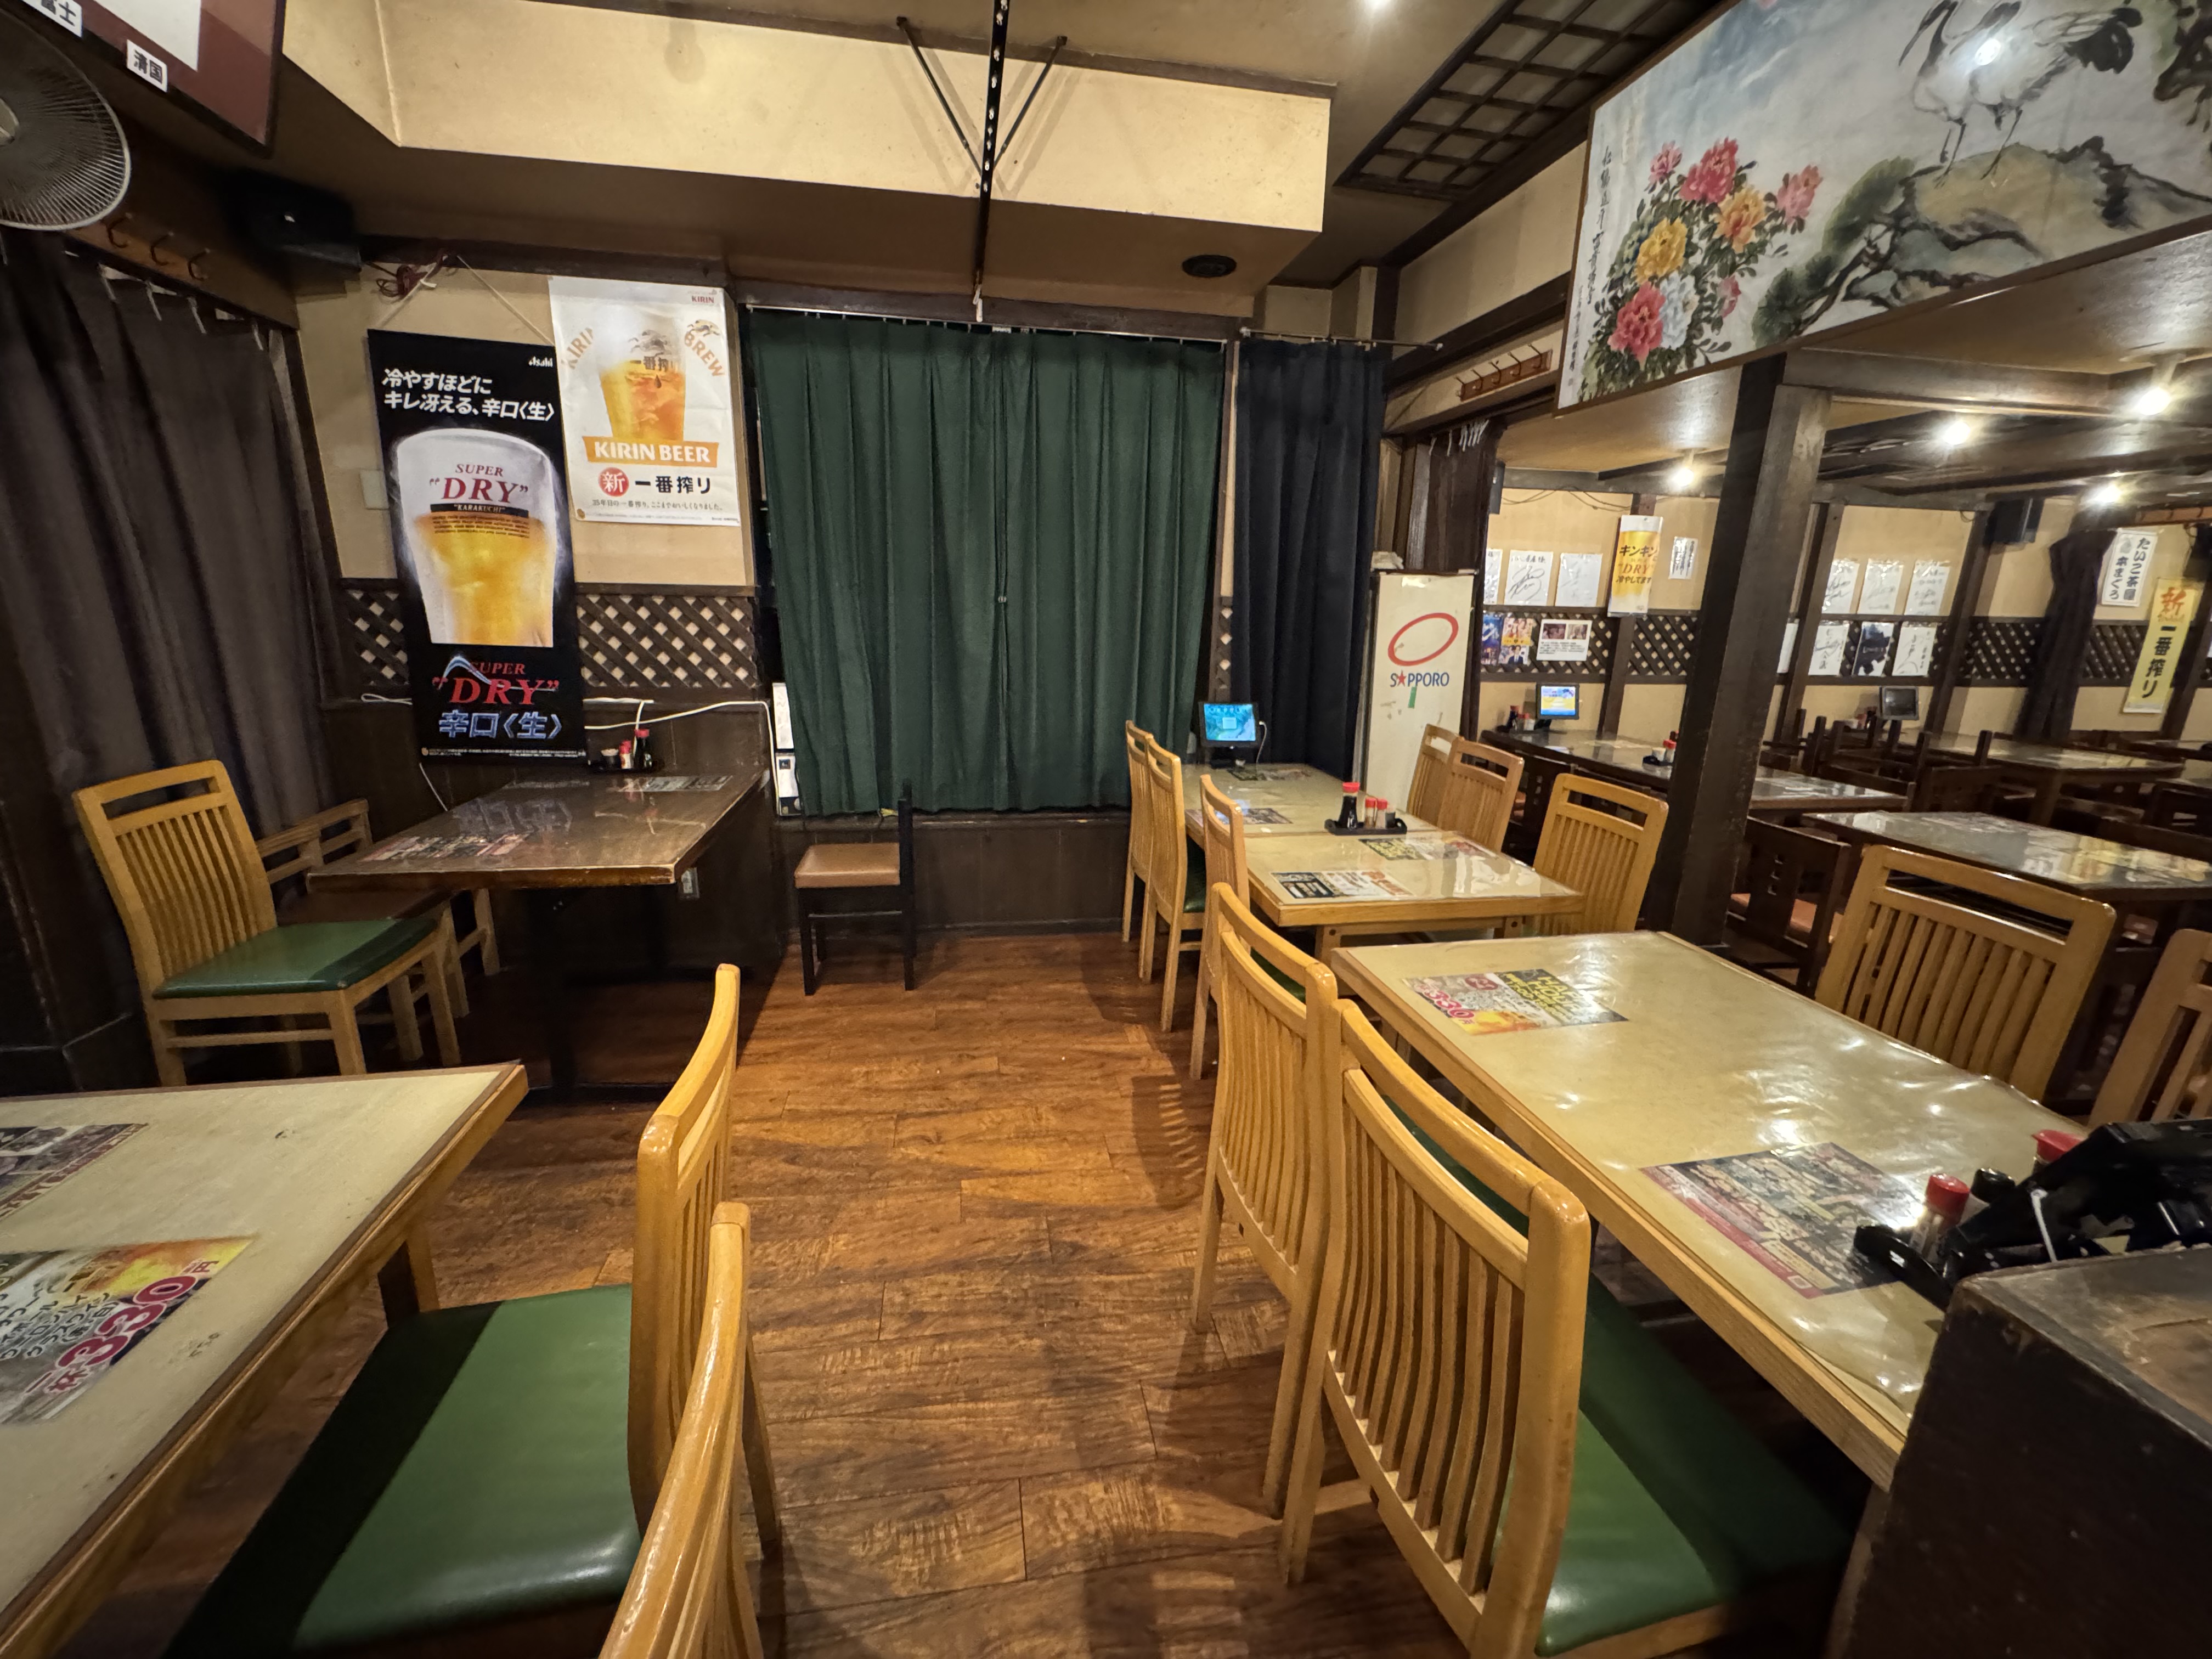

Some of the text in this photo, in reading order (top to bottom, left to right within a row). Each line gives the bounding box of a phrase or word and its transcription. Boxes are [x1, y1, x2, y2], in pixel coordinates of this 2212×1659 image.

[528, 356, 554, 368] Asahi
[684, 331, 726, 377] BREW
[381, 368, 493, 395] 冷やすほどに
[594, 441, 711, 463] KIRIN BEER
[455, 464, 504, 477] SUPER
[601, 471, 626, 493] 新
[635, 475, 712, 495] 一番搾り
[468, 662, 526, 675] SUPER
[2142, 626, 2177, 699] 一番搾り
[1423, 990, 1475, 1019] 330
[57, 1276, 197, 1368] 330
